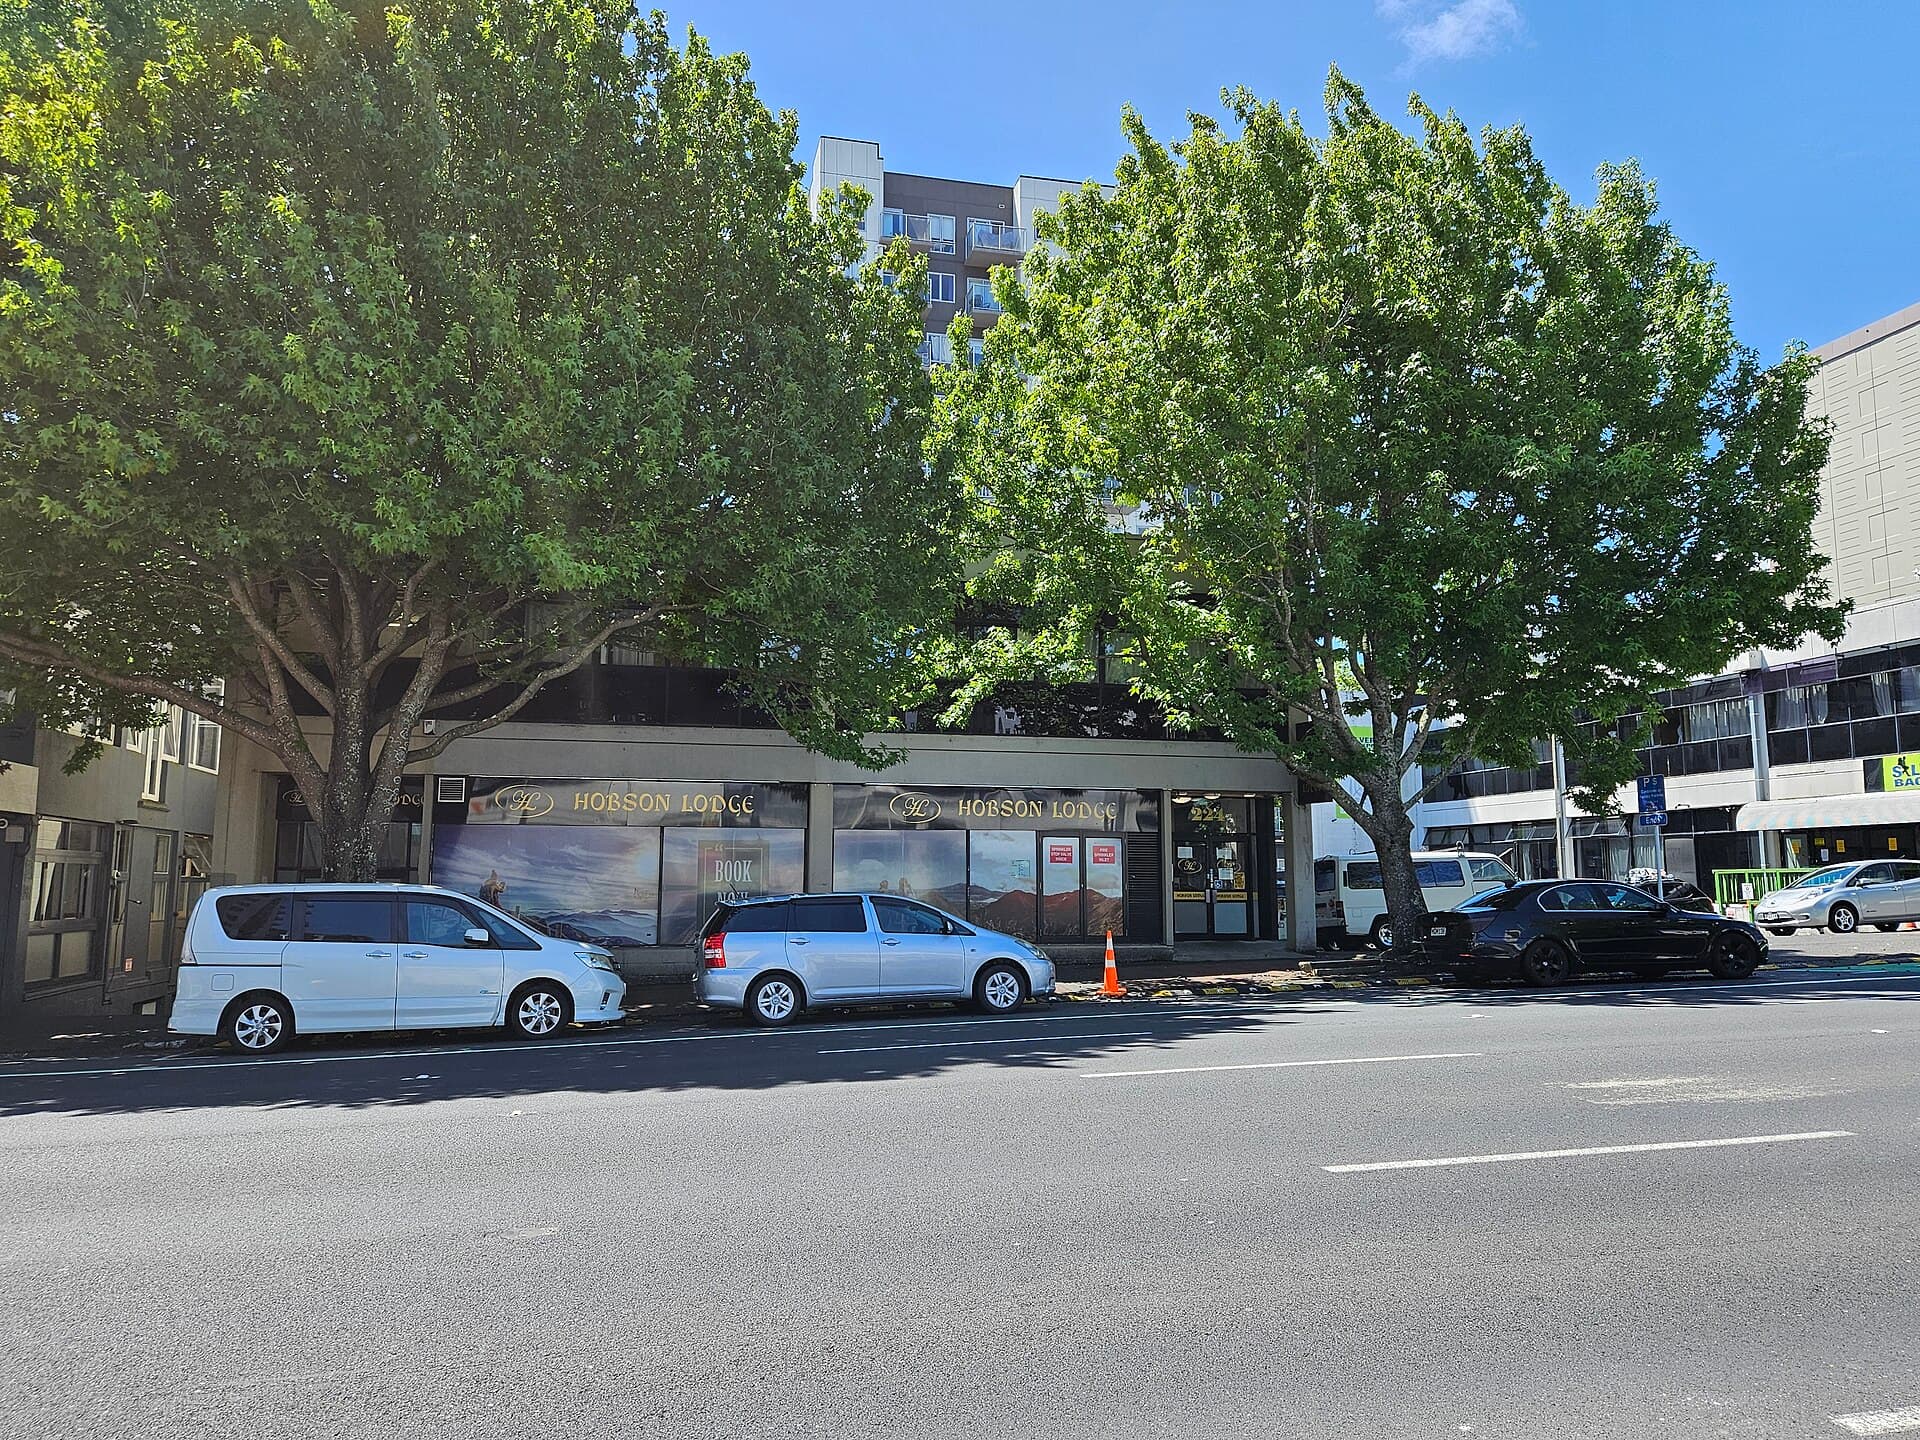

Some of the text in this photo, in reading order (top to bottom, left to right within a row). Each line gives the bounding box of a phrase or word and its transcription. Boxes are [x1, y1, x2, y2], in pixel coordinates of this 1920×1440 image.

[573, 791, 754, 818] HOBSON LODGE
[957, 799, 1118, 820] HOBSON LODGE
[1190, 807, 1226, 822] 224
[714, 859, 753, 883] BOOK
